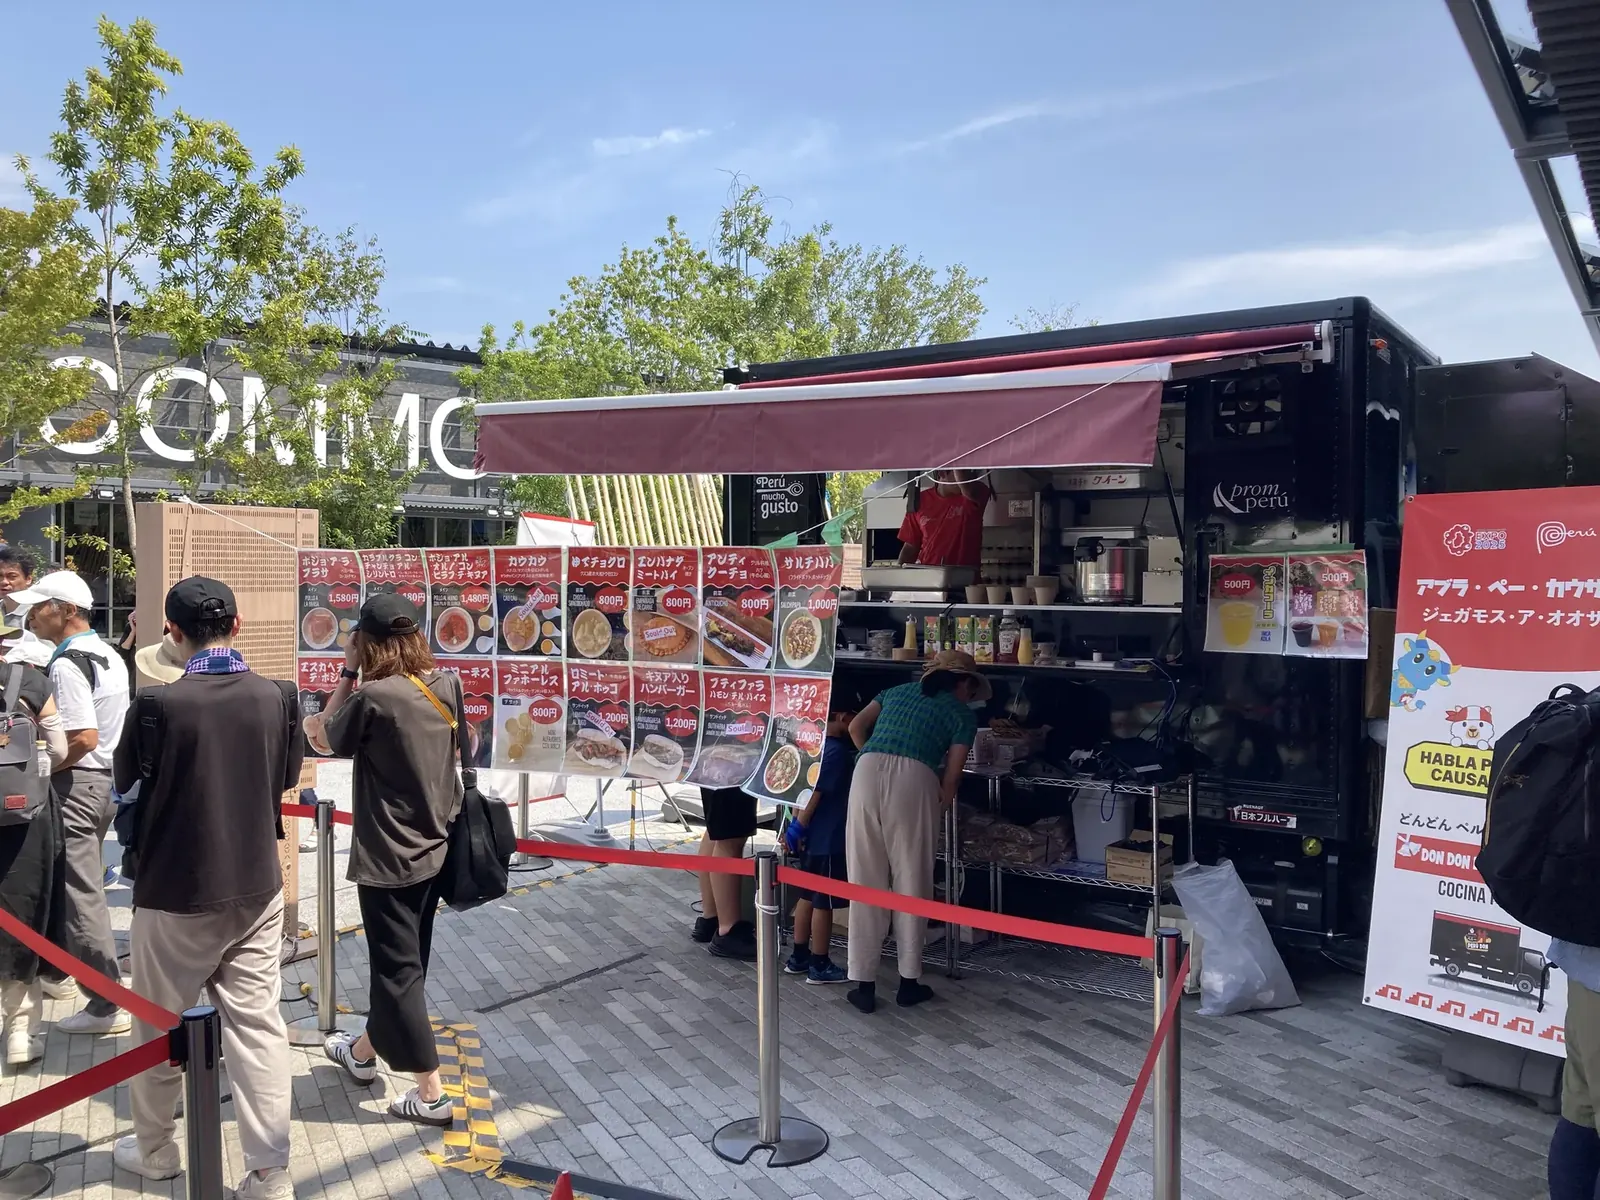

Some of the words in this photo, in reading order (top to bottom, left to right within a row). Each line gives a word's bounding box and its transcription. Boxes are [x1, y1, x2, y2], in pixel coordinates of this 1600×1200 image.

[756, 474, 785, 488] Perú
[1230, 484, 1280, 501] prom
[761, 498, 798, 519] gusto
[1246, 492, 1289, 512] perú
[1475, 530, 1507, 541] EXPO
[1475, 540, 1506, 550] 2025
[508, 555, 547, 567] カウカウ
[707, 553, 746, 565] アンティ
[707, 566, 748, 579] クーチョ
[1322, 572, 1349, 582] 500円
[1224, 580, 1251, 589] 500円
[328, 593, 359, 604] 1,580円
[461, 593, 490, 604] 1,480円
[598, 595, 624, 606] 800円
[666, 597, 691, 608] 800円
[741, 598, 769, 610] 800円
[808, 598, 838, 612] 1,000円
[510, 663, 549, 674] ミニアル
[645, 671, 690, 684] キヌア入り
[640, 683, 696, 697] ハンバーガー
[532, 707, 558, 718] 800円
[665, 717, 697, 730] 1,200円
[1420, 751, 1477, 770] HABLA
[1481, 758, 1492, 771] P
[1431, 768, 1488, 787] CAUSA
[1241, 811, 1292, 824] 日本フルハー
[1400, 813, 1452, 832] どんどん
[1456, 822, 1484, 835] ペル
[1421, 848, 1445, 865] DON
[1446, 852, 1471, 869] DON
[1438, 880, 1486, 903] COCINA
